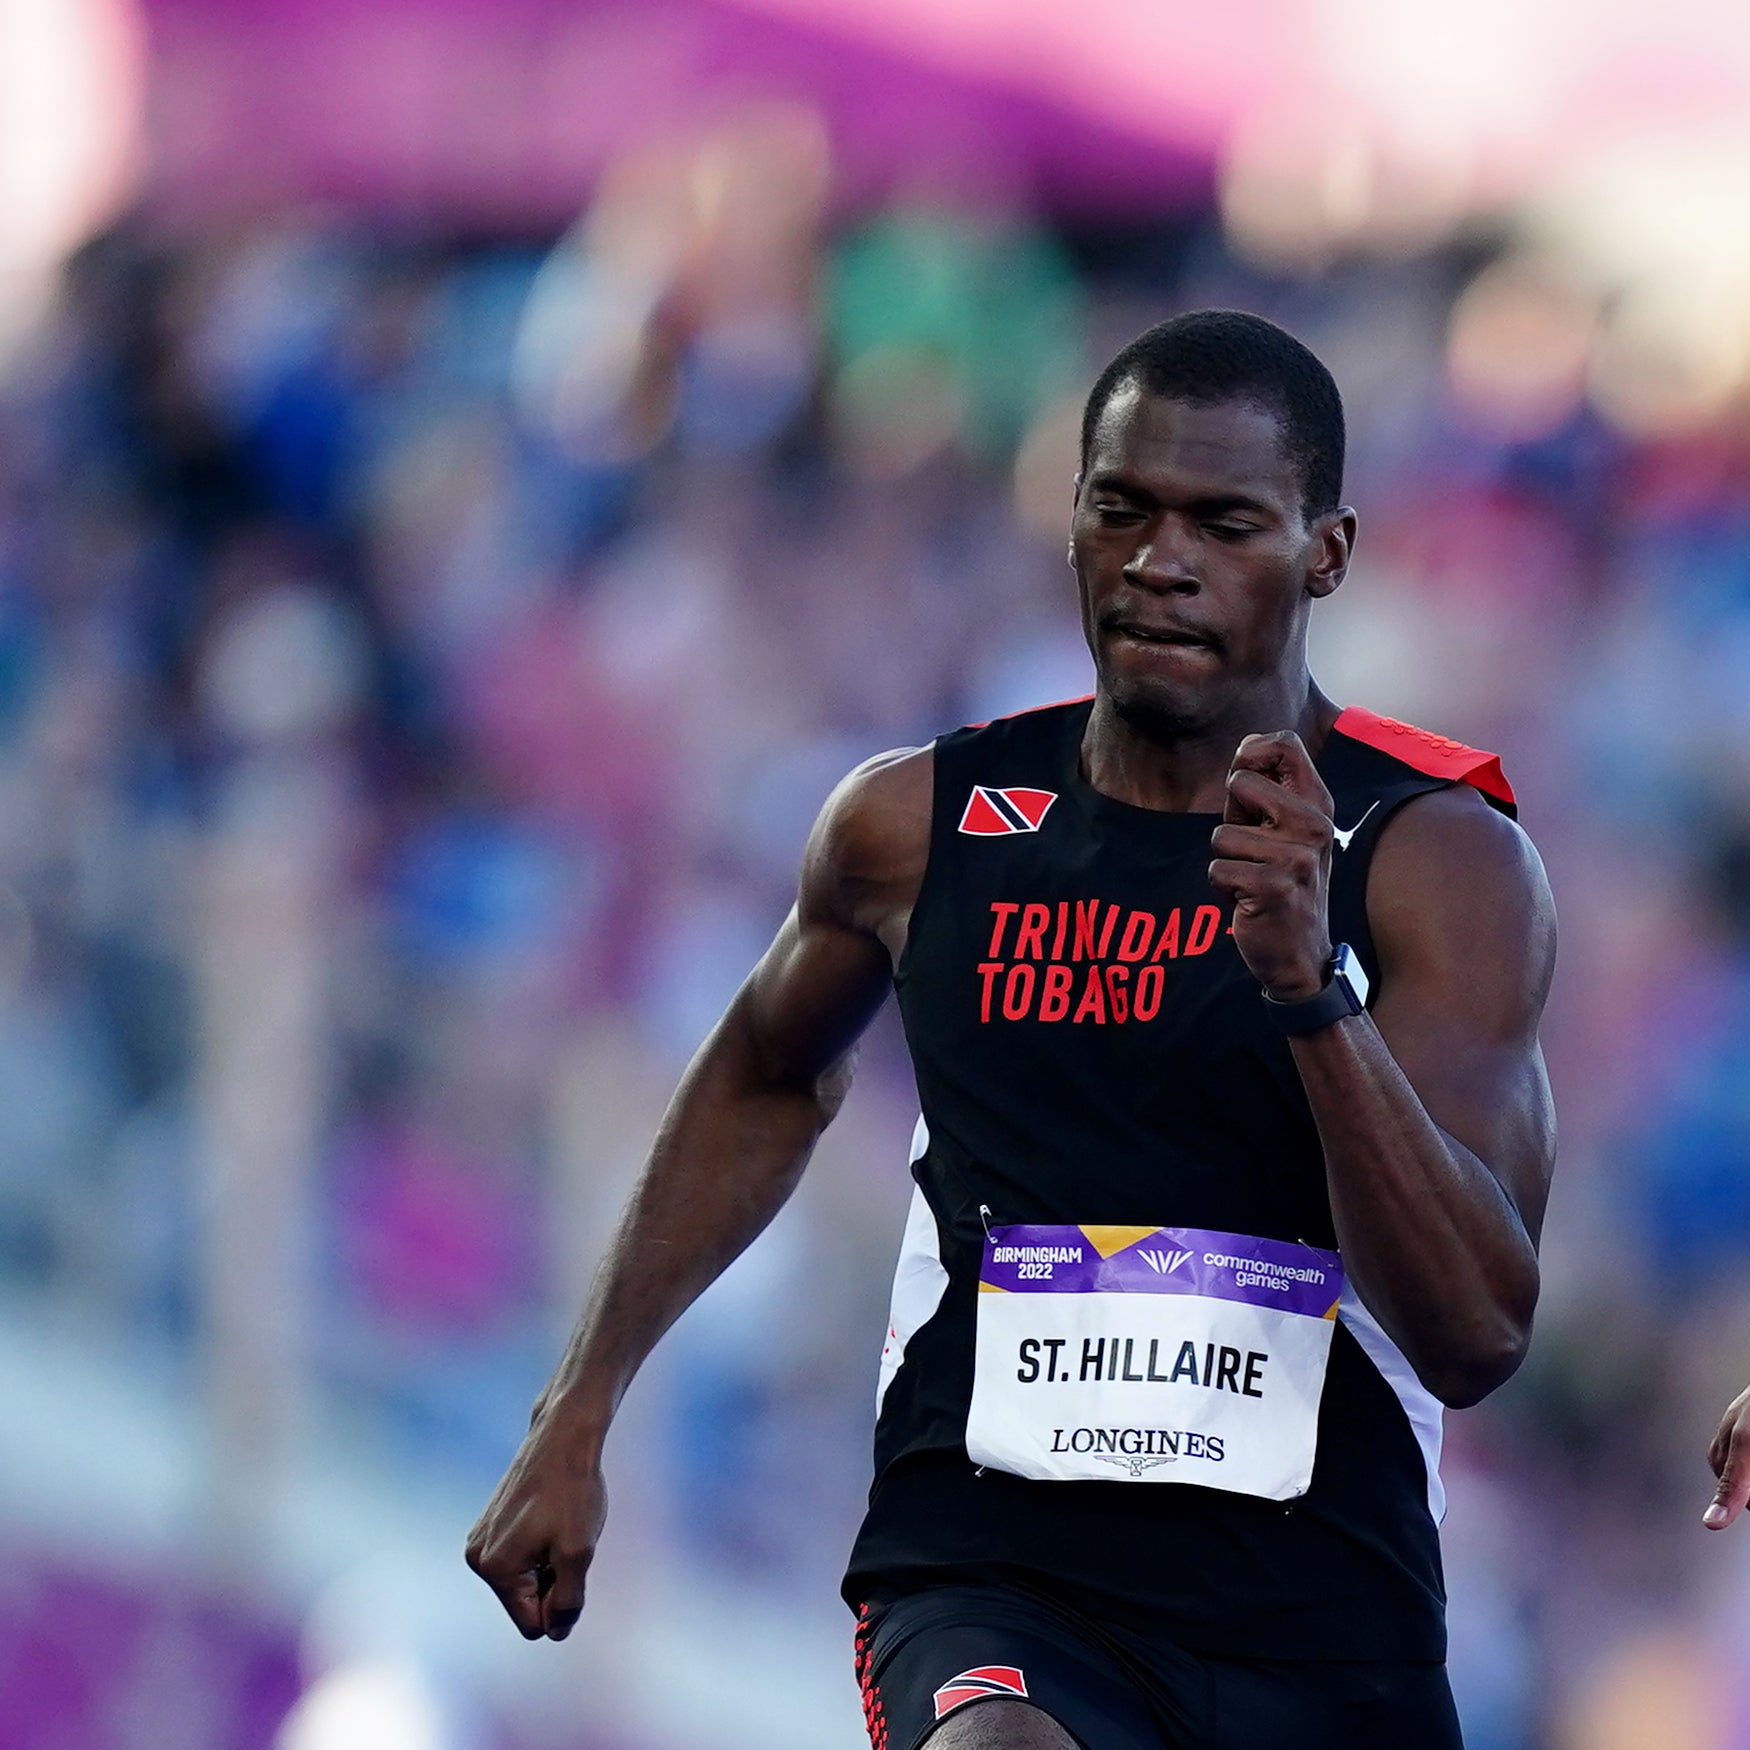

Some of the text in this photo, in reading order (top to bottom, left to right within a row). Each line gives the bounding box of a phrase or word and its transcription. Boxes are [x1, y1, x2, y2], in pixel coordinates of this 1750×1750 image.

[988, 899, 1221, 962] TRINIDAD
[977, 963, 1165, 1024] TOBAGO
[993, 1246, 1082, 1264] BIRMINGHAM
[1017, 1263, 1053, 1280] 2022
[1203, 1252, 1326, 1285] commonwealth
[1235, 1270, 1290, 1292] games
[1050, 1427, 1225, 1462] LONGINES
